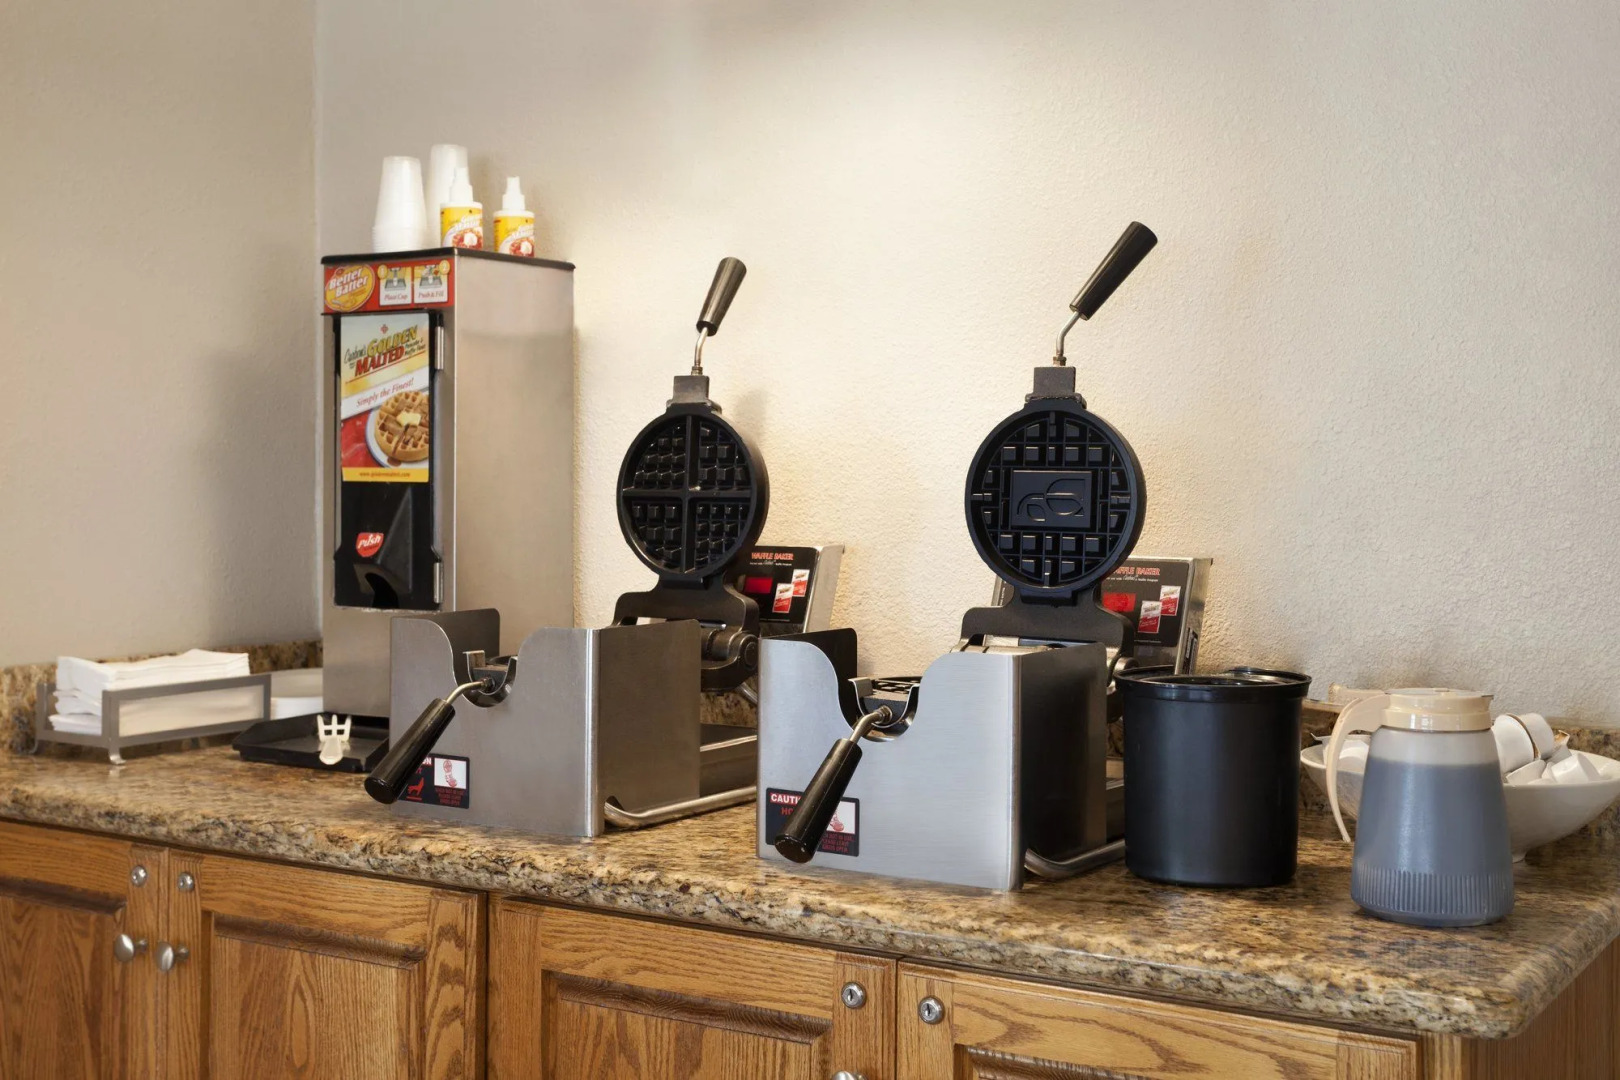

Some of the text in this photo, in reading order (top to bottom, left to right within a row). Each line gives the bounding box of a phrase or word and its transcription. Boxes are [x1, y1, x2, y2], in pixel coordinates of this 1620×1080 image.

[329, 268, 362, 290] Better
[335, 276, 368, 298] Batter
[367, 325, 418, 357] GOLDEN
[354, 346, 405, 377] MALTED
[356, 377, 414, 407] Simply the Finest!
[751, 552, 794, 561] WAFFLE BAKER
[1136, 567, 1161, 576] BAKER
[771, 793, 801, 804] CAUTI
